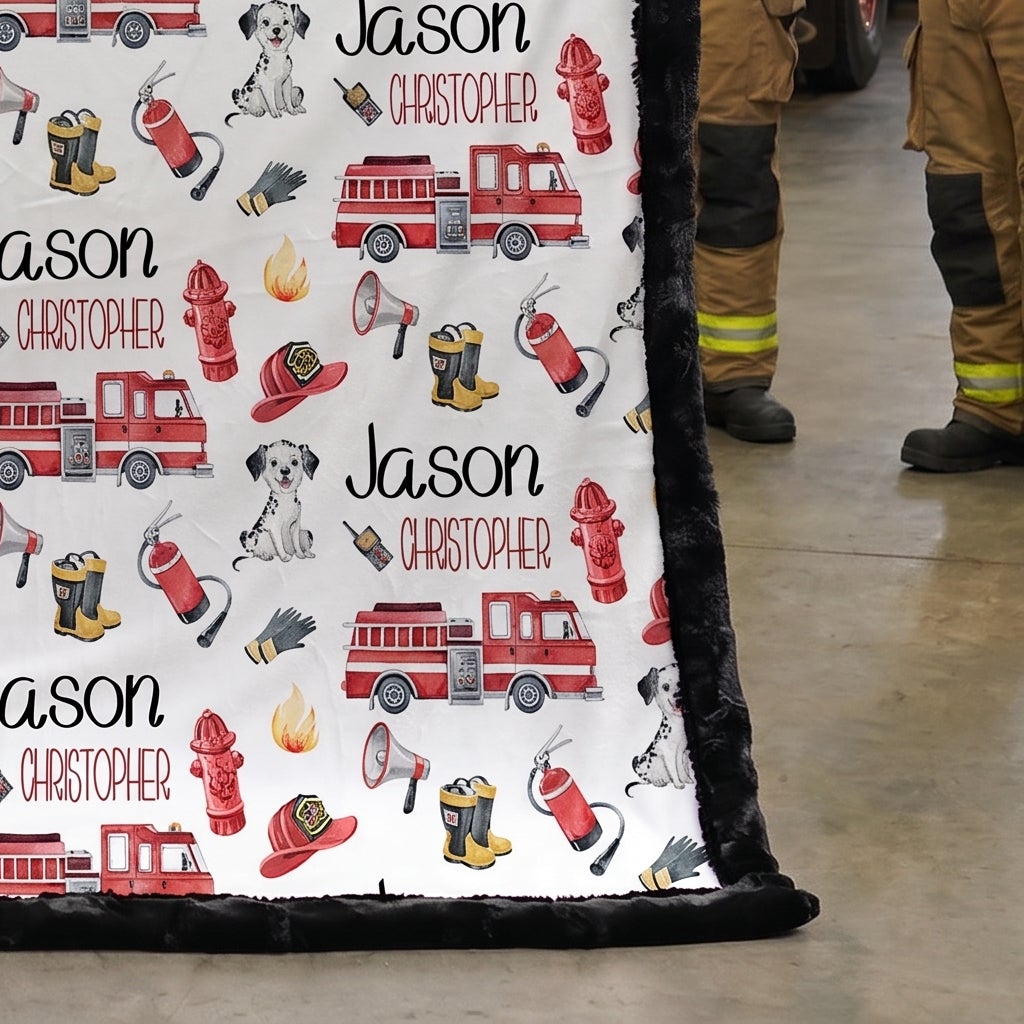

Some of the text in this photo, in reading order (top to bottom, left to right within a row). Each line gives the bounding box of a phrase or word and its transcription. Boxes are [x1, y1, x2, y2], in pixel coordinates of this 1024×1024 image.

[390, 72, 537, 125] CHRISTOPHER
[18, 298, 164, 351] CHRISTOPHER
[346, 422, 544, 499] Jason
[401, 517, 550, 571] CHRISTOPHER
[21, 748, 170, 802] CHRISTOPHER
